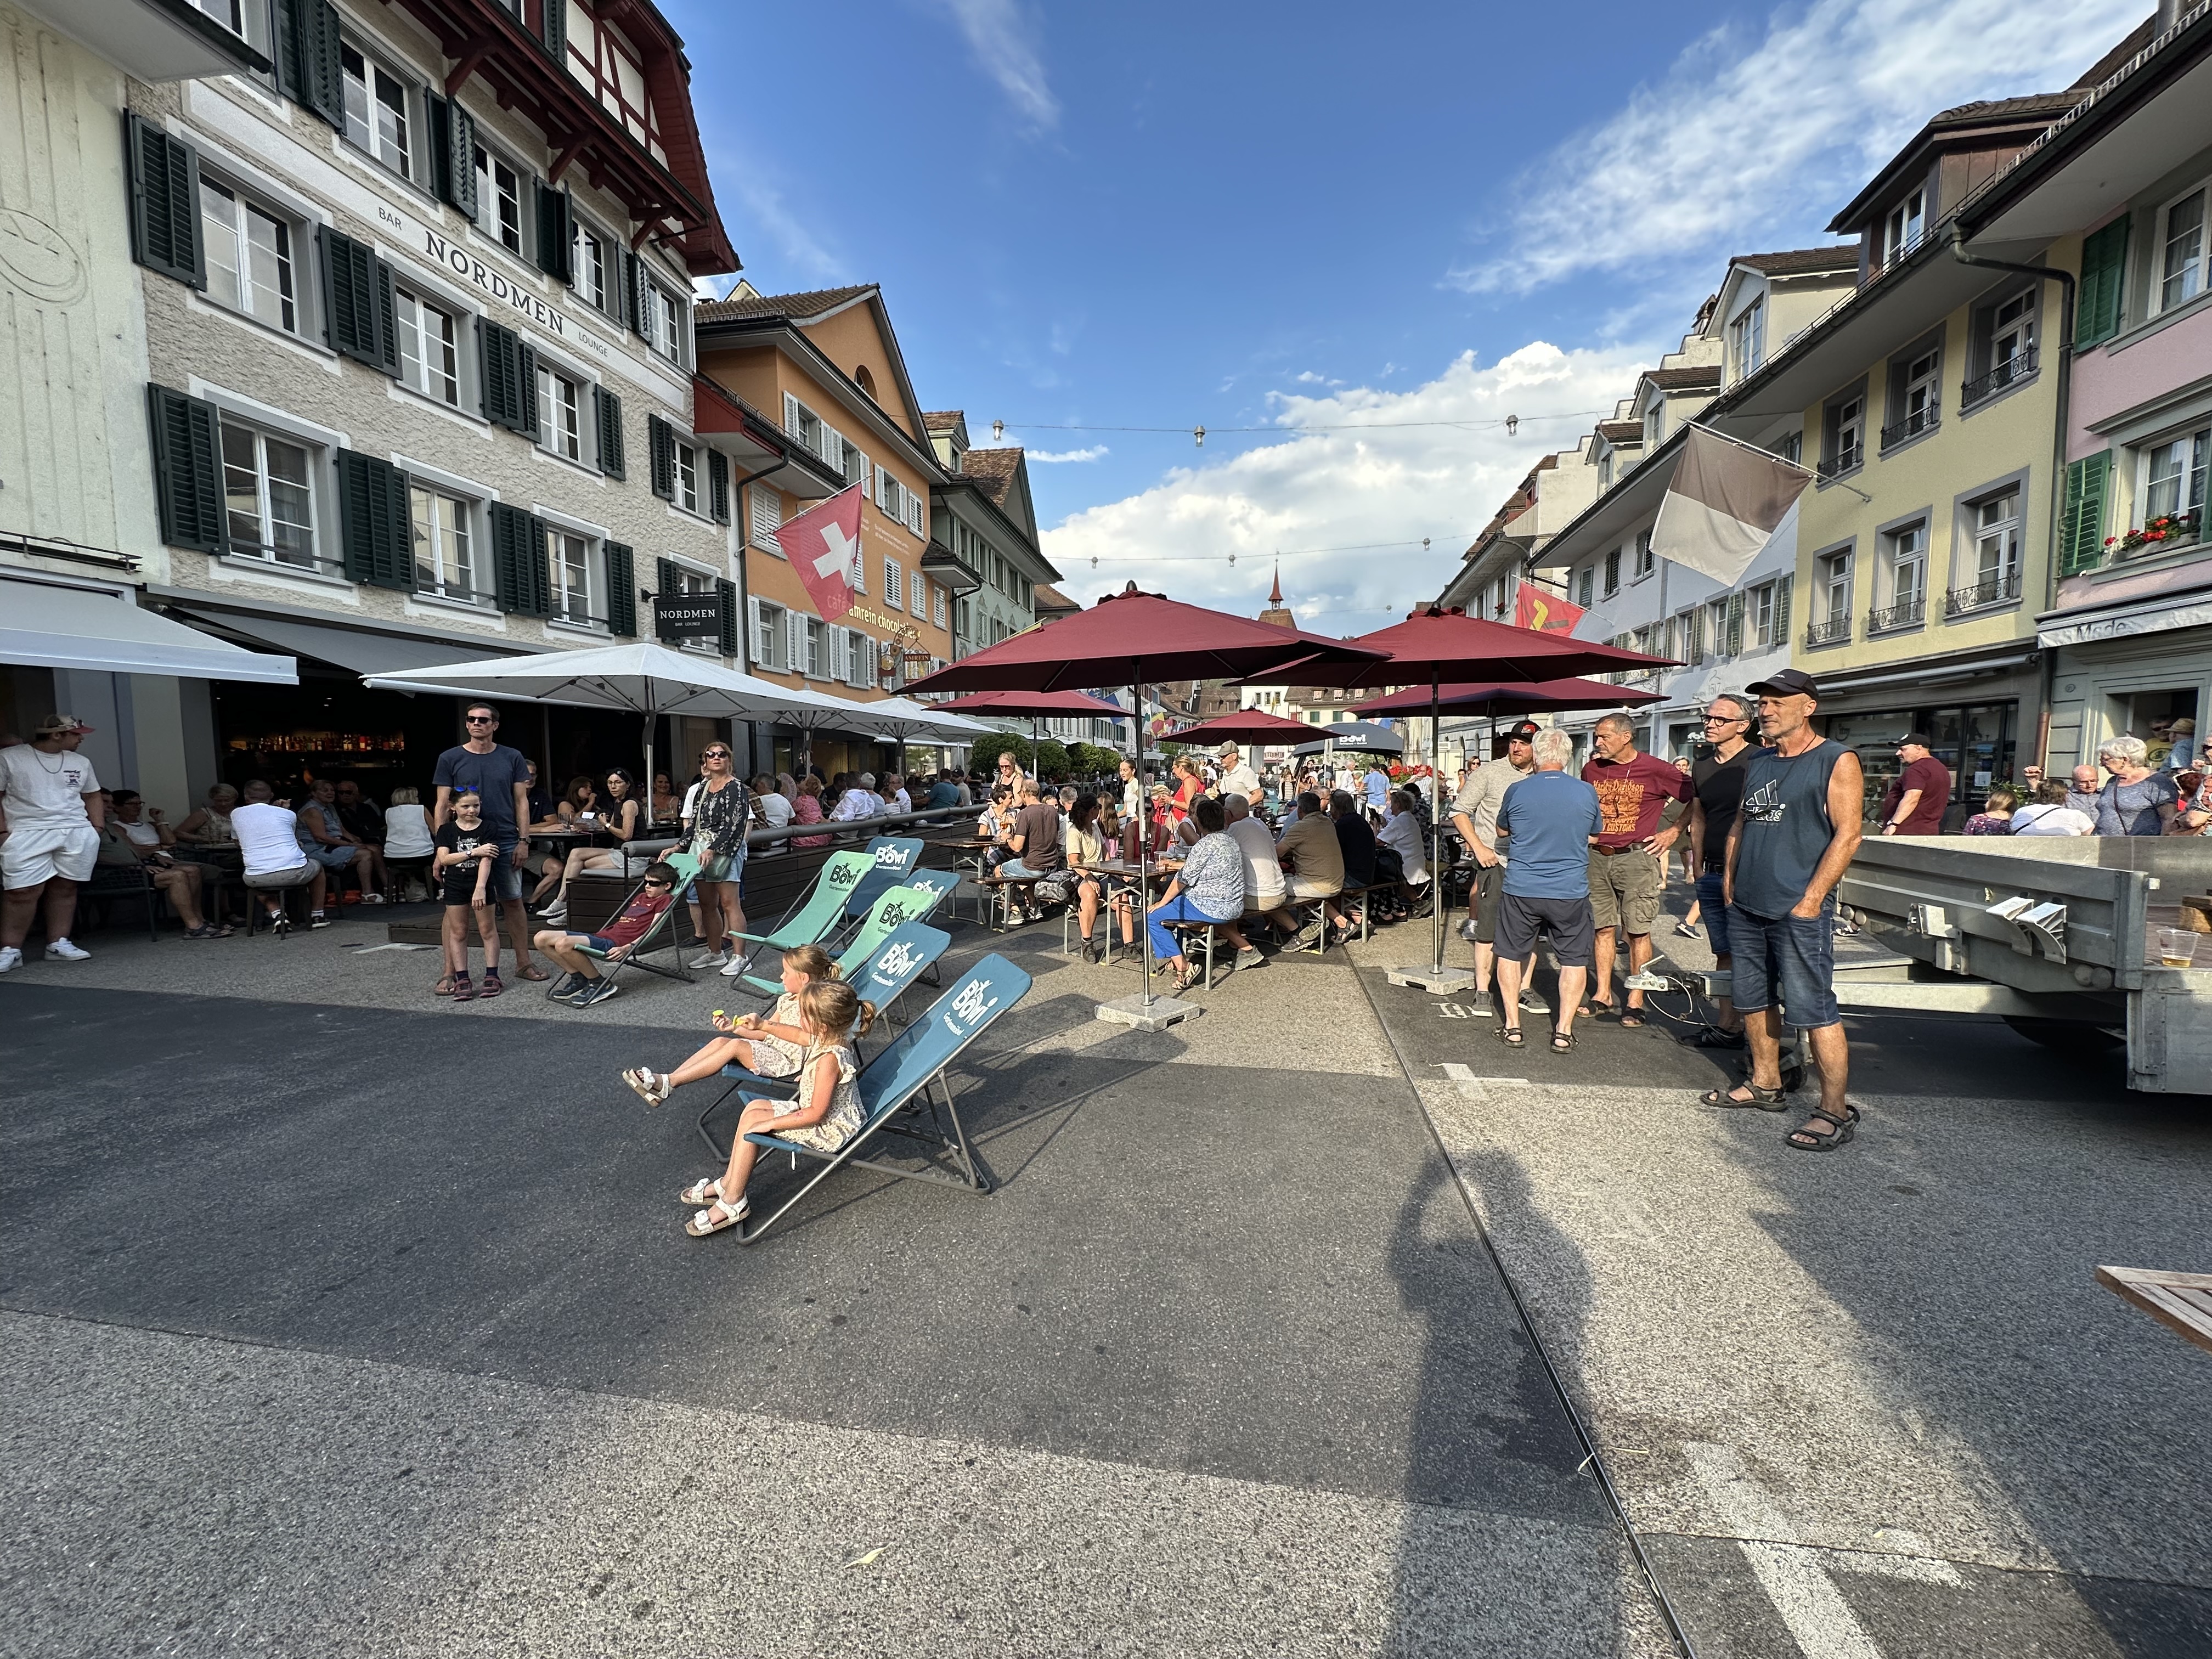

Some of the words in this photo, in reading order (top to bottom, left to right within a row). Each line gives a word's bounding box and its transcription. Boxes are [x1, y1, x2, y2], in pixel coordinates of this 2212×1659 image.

[379, 207, 402, 230] BAR
[425, 230, 563, 335] NORDMEN
[578, 331, 608, 358] LOUNGE
[659, 609, 716, 619] NORDMEN
[848, 605, 877, 625] amrein
[1708, 682, 1722, 696] 1517
